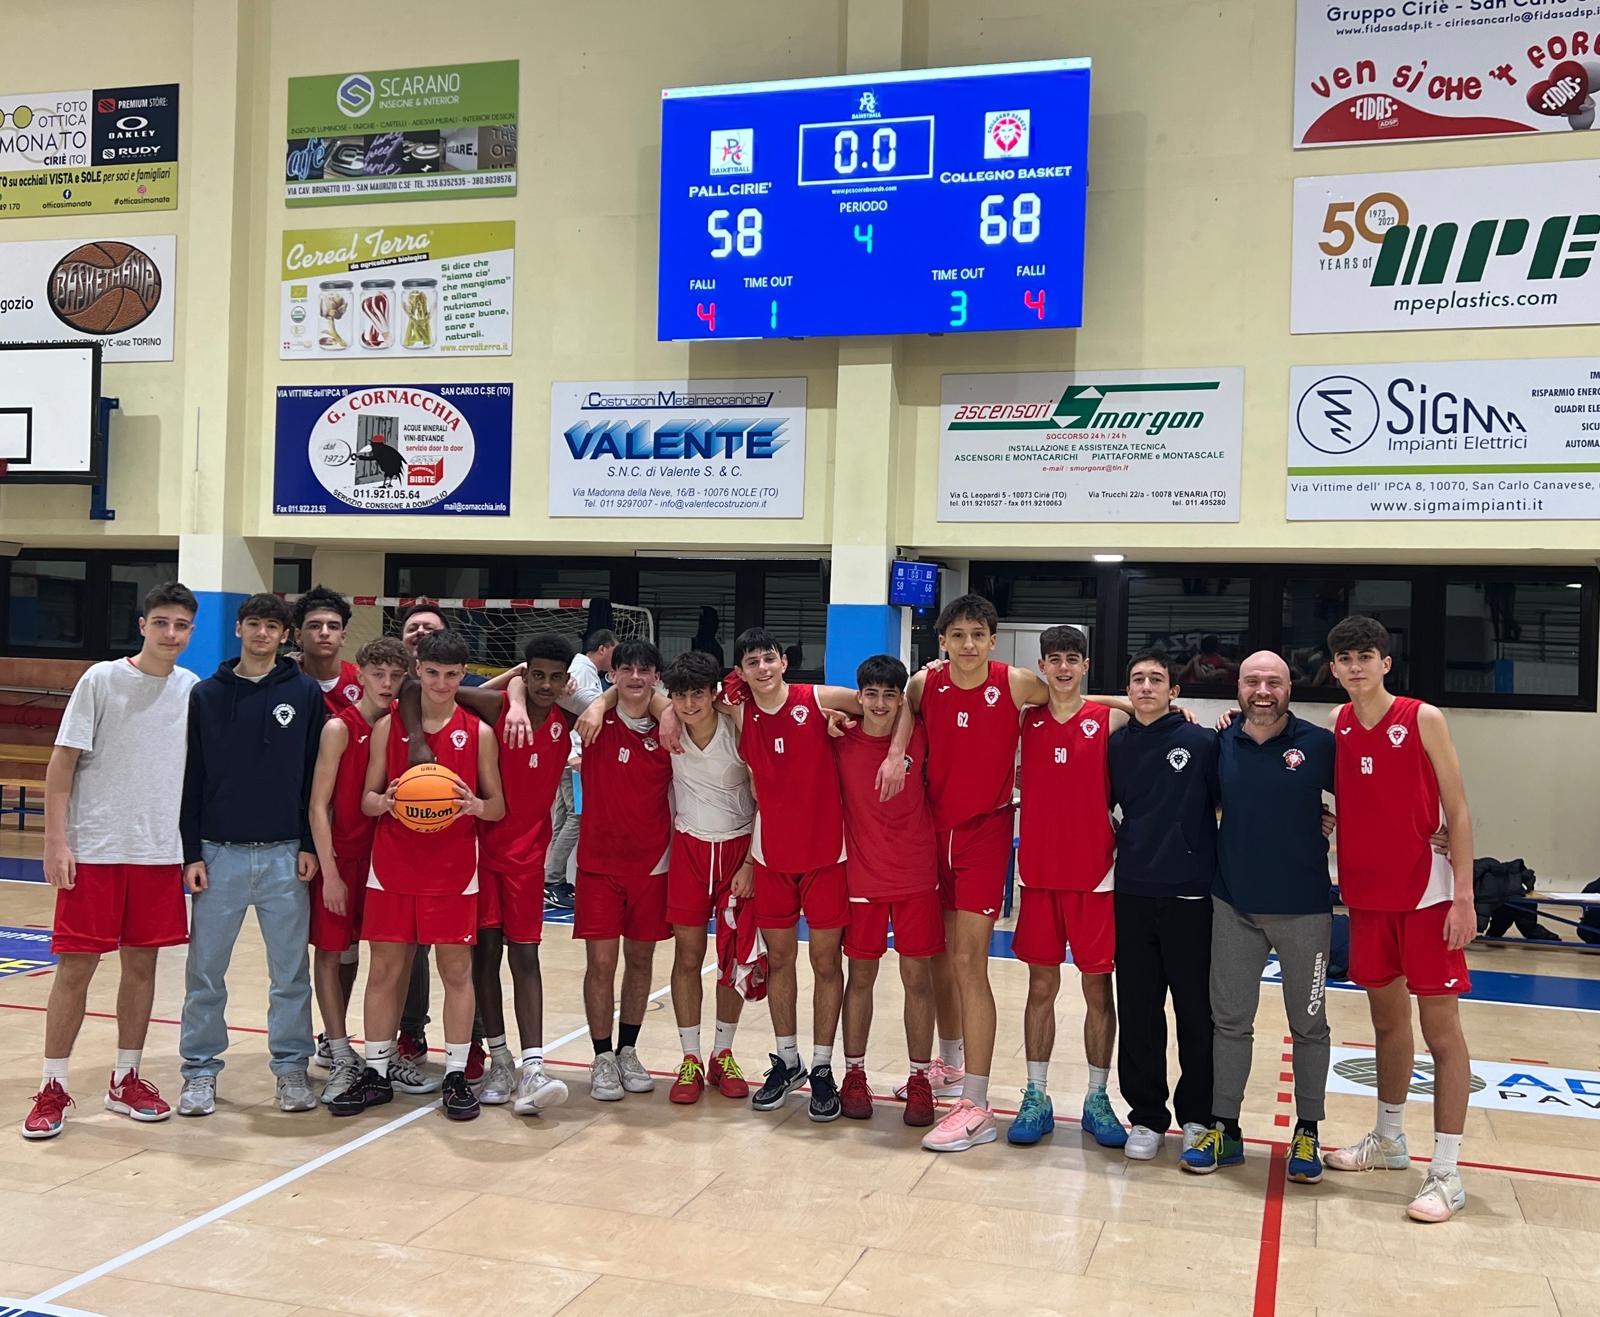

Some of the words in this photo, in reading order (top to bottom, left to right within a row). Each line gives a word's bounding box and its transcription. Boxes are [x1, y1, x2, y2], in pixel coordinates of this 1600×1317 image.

[1327, 5, 1396, 25] Gruppo
[1336, 19, 1433, 36] www.fidasadsp.it
[380, 73, 460, 97] SCARANO
[57, 101, 87, 113] FOTO
[118, 99, 148, 109] PREMIUM
[379, 99, 413, 109] INSEGNE
[423, 95, 460, 107] INTERIOR
[1355, 96, 1393, 121] FIDAS
[39, 113, 86, 128] OTTICA
[108, 130, 155, 139] OAKLEY
[118, 145, 160, 155] RUDY
[834, 127, 897, 174] 0.0
[44, 153, 66, 165] CIRIÈ
[69, 154, 86, 166] (TO)
[19, 174, 47, 186] occhiali
[49, 173, 73, 185] VISTA
[81, 171, 101, 183] SOLE
[102, 173, 115, 184] per
[116, 170, 130, 181] soci
[135, 167, 171, 182] famigliari
[940, 170, 1015, 184] COLLEGNO
[1017, 165, 1072, 179] BASKET
[356, 183, 368, 191] SAN
[688, 182, 772, 198] PALL.CIRIE'
[839, 200, 888, 213] PERIODO
[979, 192, 1041, 245] 68
[1318, 192, 1409, 256] 50
[1369, 209, 1386, 218] 1973
[1378, 216, 1395, 226] 2023
[707, 208, 763, 258] 58
[853, 223, 873, 253] 4
[286, 233, 358, 272] Cereal
[364, 229, 431, 258] Terra
[1370, 214, 1600, 287] MPE
[441, 263, 450, 271] Si
[452, 262, 471, 270] dice
[473, 260, 489, 268] che
[1320, 257, 1358, 270] YEARS
[1362, 256, 1373, 269] of
[931, 268, 957, 281] TIME
[960, 267, 985, 280] OUT
[1016, 264, 1046, 277] FALLI
[54, 252, 156, 311] BASKETMANIA
[442, 283, 458, 291] che
[460, 276, 511, 288] mangiamo"
[689, 279, 716, 291] FALLI
[743, 276, 767, 289] TIME
[770, 275, 793, 288] OUT
[451, 292, 478, 300] allora
[1393, 290, 1558, 315] mpeplastics.com
[0, 296, 33, 312] gozio
[443, 299, 492, 311] nutriamoci
[950, 290, 968, 327] 3
[1024, 289, 1045, 320] 4
[444, 312, 452, 321] di
[455, 312, 476, 320] cose
[478, 308, 509, 317] buone,
[696, 302, 716, 331] 4
[445, 323, 466, 331] sane
[133, 337, 161, 346] TORINO
[445, 330, 485, 341] naturali.
[440, 343, 508, 352] www.cerealterra.it
[277, 389, 288, 398] VIA
[288, 389, 313, 398] VITTIME
[440, 387, 455, 396] SAN
[456, 387, 479, 396] CARLO
[497, 386, 511, 396] (TO)
[1531, 388, 1575, 397] RISPARMIO
[588, 392, 656, 407] Costruzioni
[658, 391, 766, 406] Metalmeccaniche
[326, 410, 346, 425] G.
[349, 389, 461, 432] CORNACCHIA
[954, 399, 1053, 420] ascensori
[1554, 405, 1585, 413] QUADRI
[403, 424, 421, 432] ACQUE
[422, 424, 448, 432] MINERALI
[403, 434, 445, 442] VINI-BEVANDE
[563, 422, 784, 460] VALENTE
[1046, 432, 1089, 440] SOCCORSO
[323, 442, 336, 451] dal
[406, 444, 428, 452] servizio
[429, 443, 442, 452] door
[450, 444, 464, 452] door
[1131, 443, 1166, 451] TECNICA
[1388, 437, 1458, 454] Impianti
[1464, 435, 1528, 450] Elettrici
[323, 454, 344, 463] 1972
[954, 453, 1003, 462] ASCENSORI
[1012, 453, 1078, 461] MONTACARICHI
[1092, 452, 1153, 460] PIATTAFORME
[1162, 451, 1225, 459] MONTASCALE
[607, 466, 642, 477] S.N.C.
[646, 466, 656, 477] di
[660, 466, 700, 477] Valente
[704, 466, 716, 477] S.
[719, 466, 727, 477] &
[731, 466, 743, 477] C.
[1042, 464, 1064, 472] e-mail
[409, 475, 436, 484] BIBITE
[1291, 482, 1310, 492] Via
[1313, 482, 1352, 492] Vittime
[1384, 482, 1411, 491] IPCA
[1430, 481, 1468, 492] 10070,
[1472, 480, 1494, 490] San
[1498, 480, 1529, 490] Carlo
[1533, 480, 1595, 490] Canavese,
[333, 489, 362, 508] SERVIZIO
[412, 490, 448, 508] DOMICILIO
[353, 488, 420, 499] 011.921.05.64
[572, 488, 585, 497] Via
[588, 488, 625, 497] Madonna
[628, 488, 647, 497] della
[649, 488, 673, 498] Neve,
[676, 488, 696, 497] 16/B
[703, 487, 729, 497] 10076
[731, 488, 758, 497] NOLE
[760, 487, 779, 498] (TO)
[949, 491, 960, 499] Via
[971, 491, 1001, 500] Leopardi
[1051, 491, 1067, 499] (TO)
[1088, 491, 1100, 499] Via
[1102, 491, 1129, 499] Trucchi
[1130, 491, 1145, 499] 22/a
[1174, 490, 1209, 498] VENARIA
[1210, 490, 1227, 499] (TO)
[276, 504, 287, 513] Fax
[443, 502, 507, 512] mail@cornacchia.info
[584, 500, 597, 508] Tel.
[600, 500, 614, 508] 011
[617, 500, 652, 508] 9297007
[660, 499, 767, 510] info@valentecostruzioni.it
[1370, 498, 1543, 514] www.sigmaimpianti.it
[957, 711, 969, 728] 62
[1054, 747, 1067, 764] 50
[1360, 756, 1373, 775] 53
[405, 805, 453, 819] Wilson
[1310, 952, 1323, 1001] COLLEGNO
